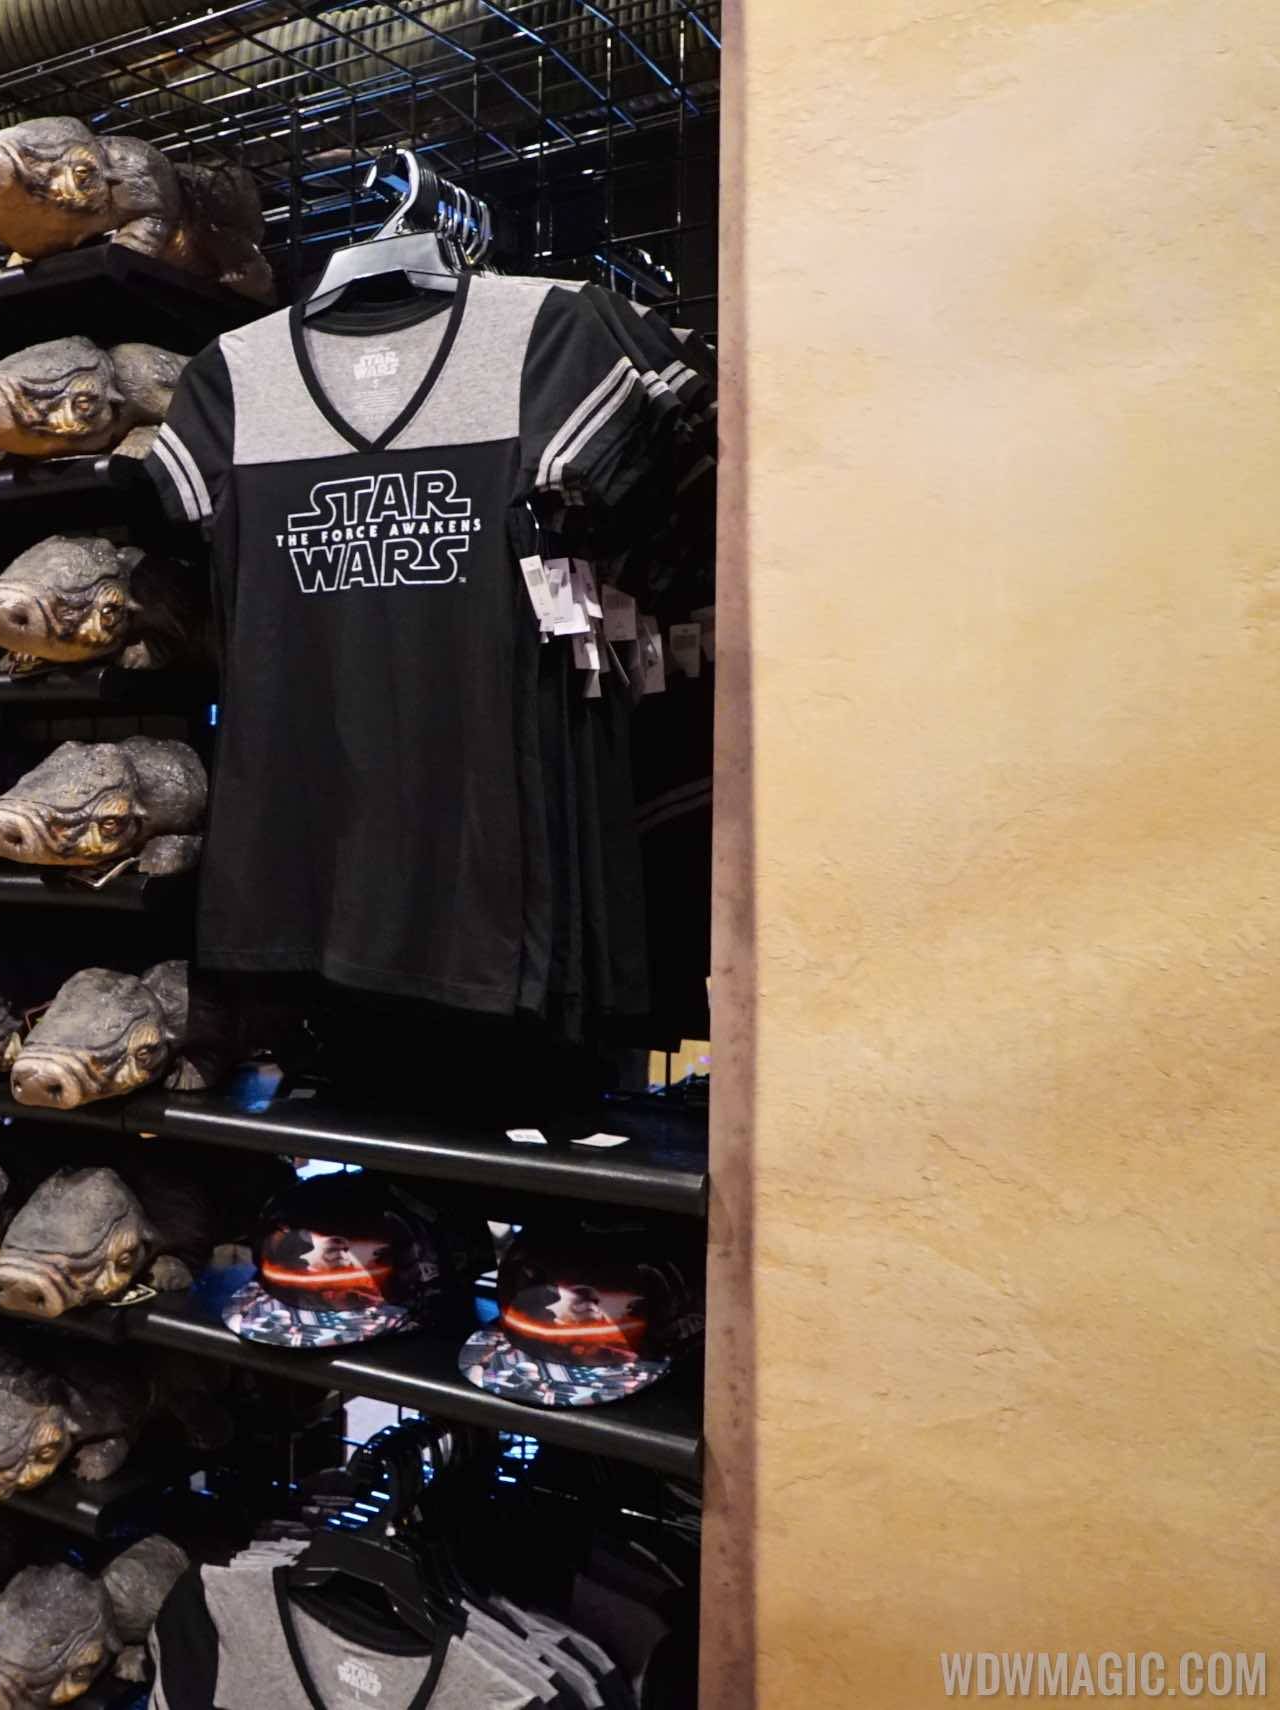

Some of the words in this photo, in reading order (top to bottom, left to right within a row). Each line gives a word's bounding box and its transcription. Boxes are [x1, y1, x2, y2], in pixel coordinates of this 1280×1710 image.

[352, 362, 399, 380] WARS
[288, 470, 471, 531] STAR
[275, 533, 309, 547] THE
[321, 524, 378, 544] FORCE
[389, 518, 481, 537] AWAKENS
[289, 535, 469, 593] WARS
